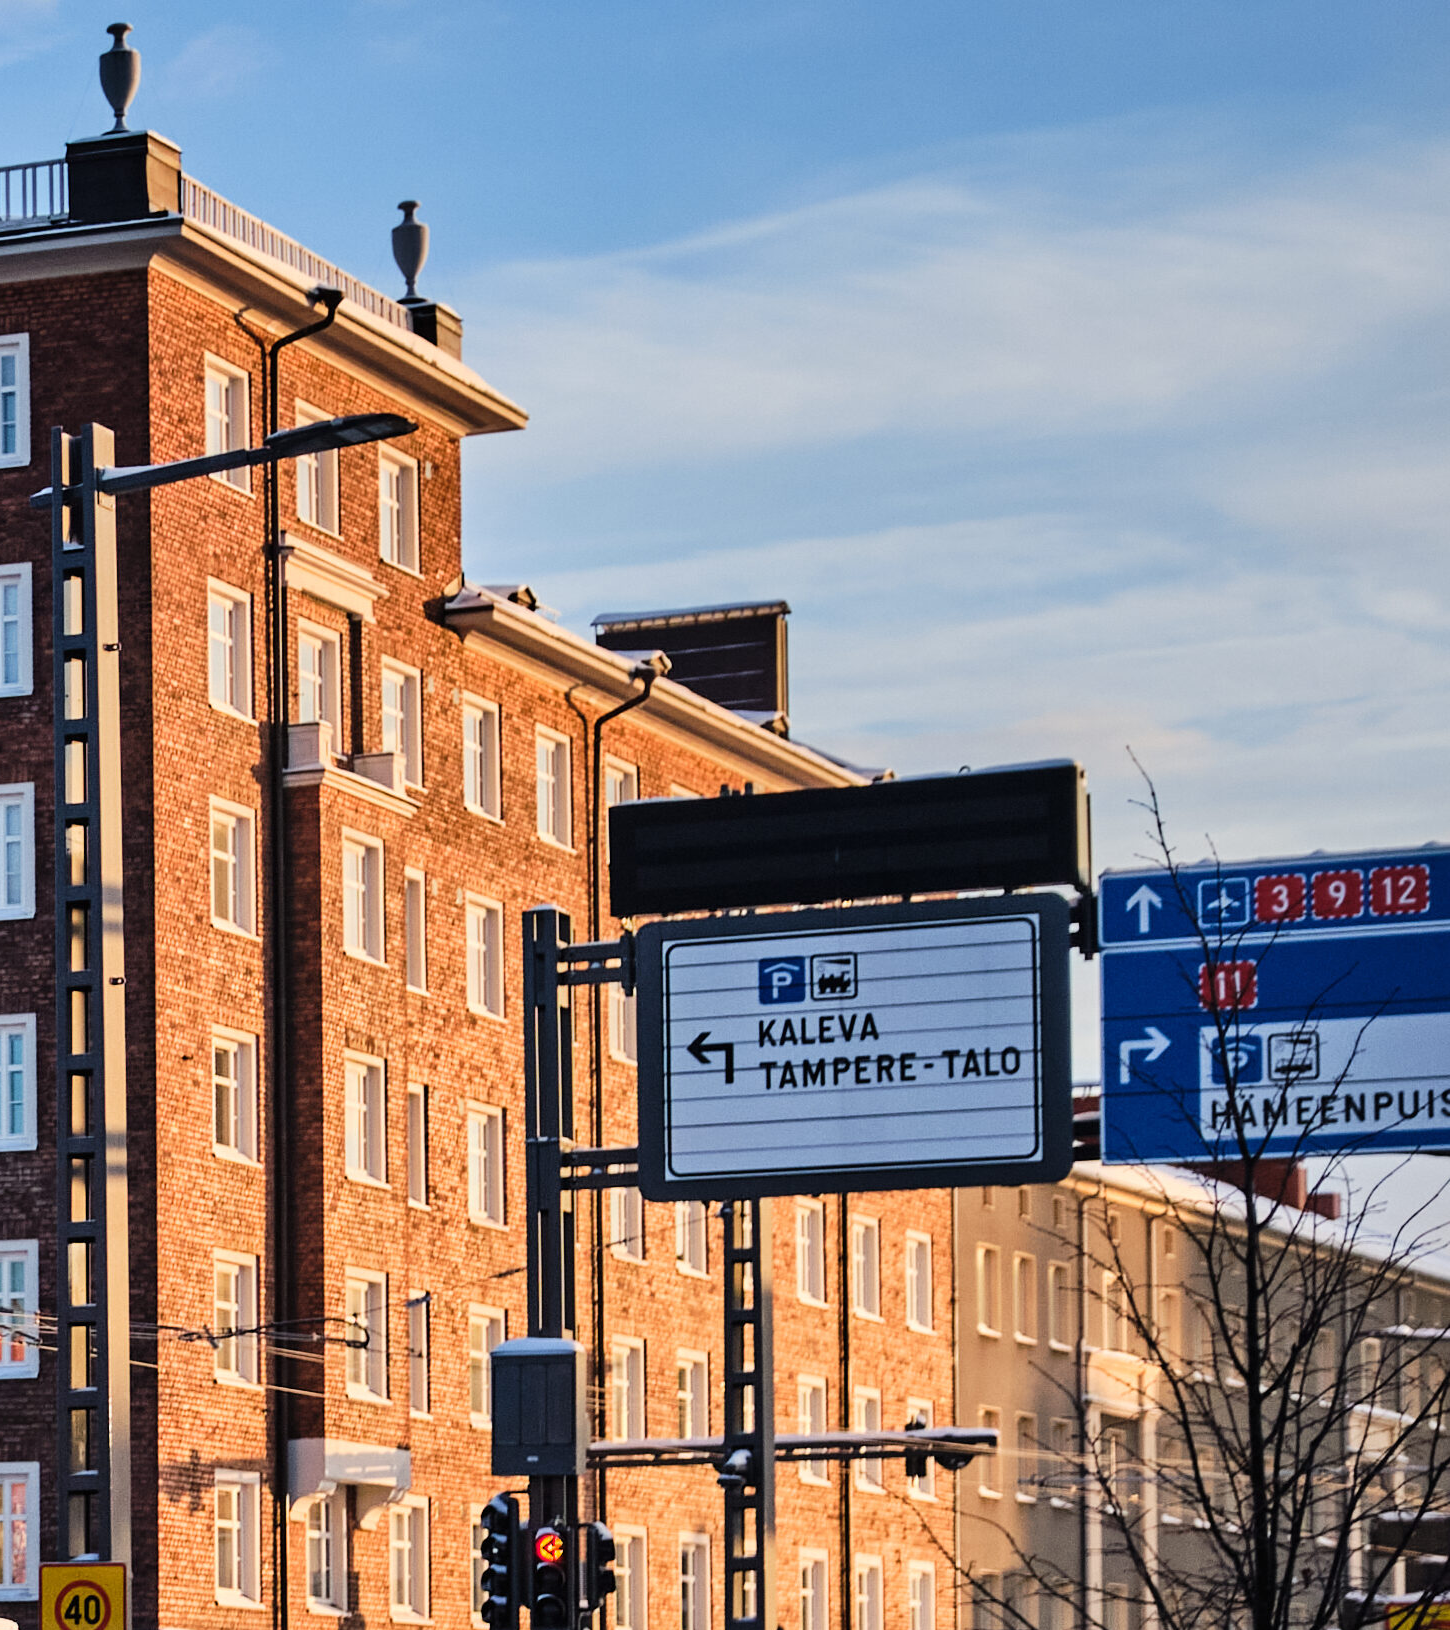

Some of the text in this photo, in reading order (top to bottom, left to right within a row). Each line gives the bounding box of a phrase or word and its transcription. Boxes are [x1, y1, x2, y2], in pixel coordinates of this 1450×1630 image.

[1271, 875, 1417, 912] 3 9 12
[1216, 970, 1242, 1000] 11
[758, 1013, 879, 1048] KALEVA
[759, 1046, 1021, 1090] TAMPERE-TALO
[64, 1594, 101, 1625] 40
